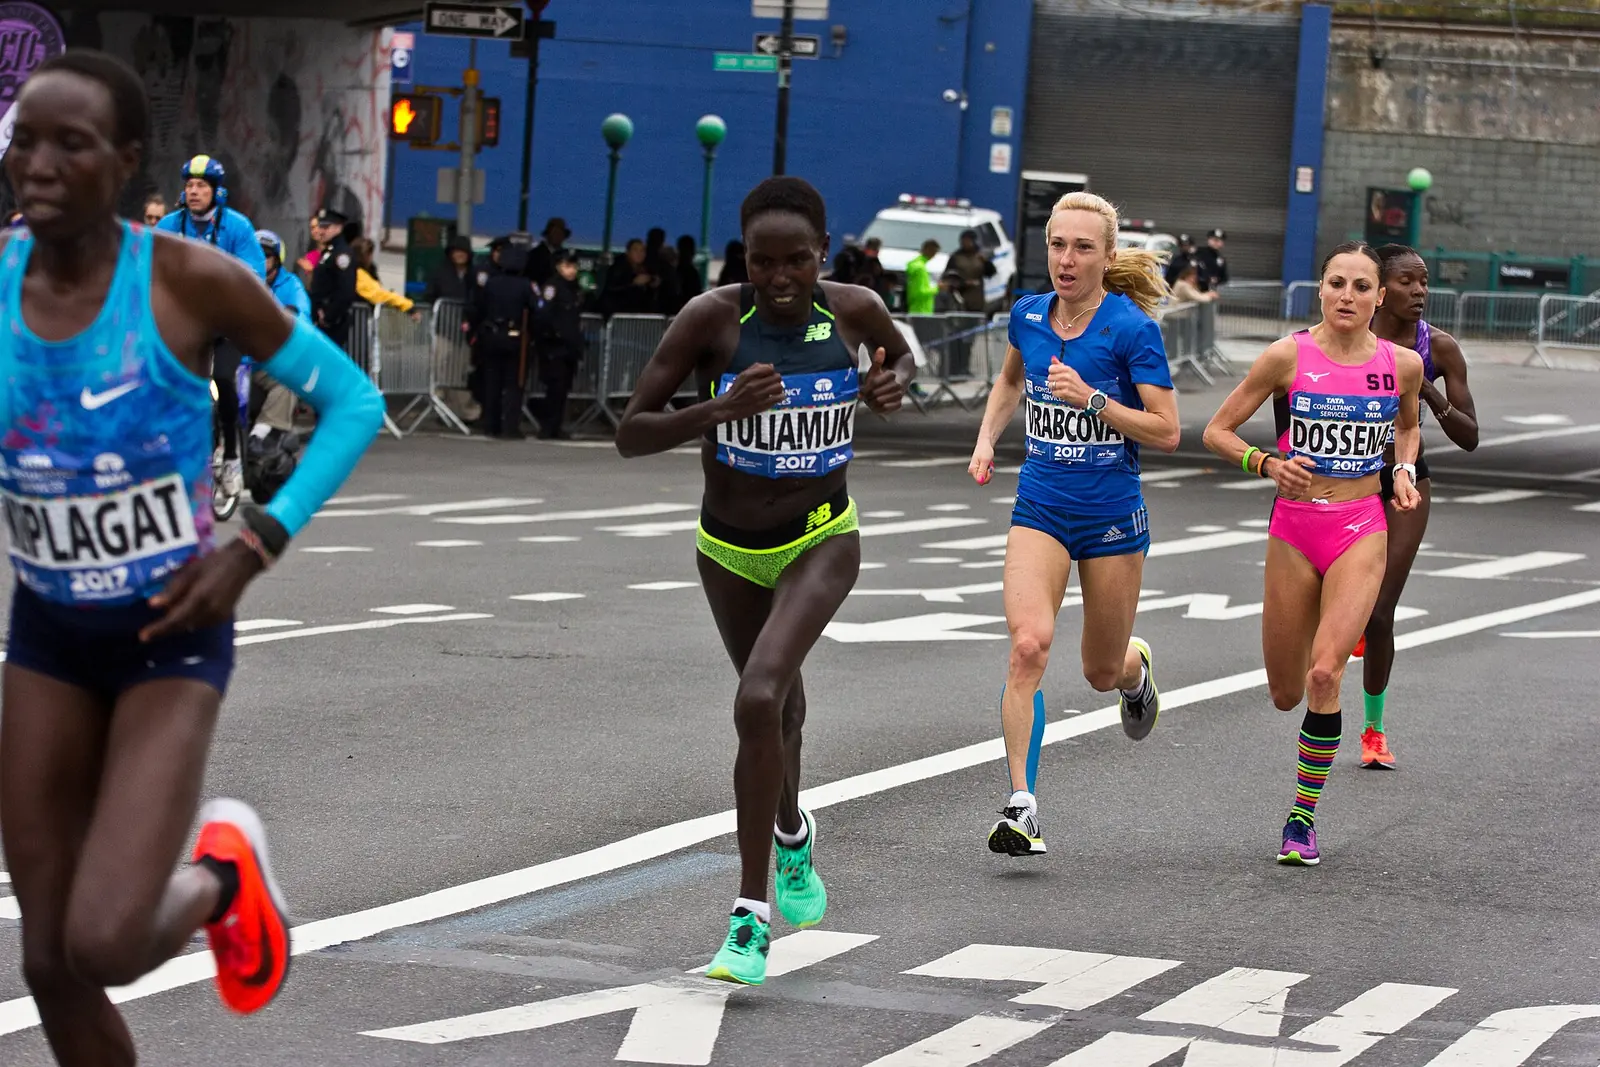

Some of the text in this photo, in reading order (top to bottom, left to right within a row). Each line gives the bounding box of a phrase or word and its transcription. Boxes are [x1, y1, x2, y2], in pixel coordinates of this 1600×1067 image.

[438, 12, 508, 29] ONE WAY
[811, 392, 835, 402] TATA
[1312, 403, 1357, 412] CONSULTANCY
[1320, 410, 1349, 418] SERVICES
[1292, 418, 1390, 456] DOSSENA
[1054, 446, 1086, 458] 2017
[775, 456, 817, 469] 2017
[1331, 460, 1364, 471] 2017
[1101, 532, 1127, 543] adidas
[69, 566, 129, 592] 2017
